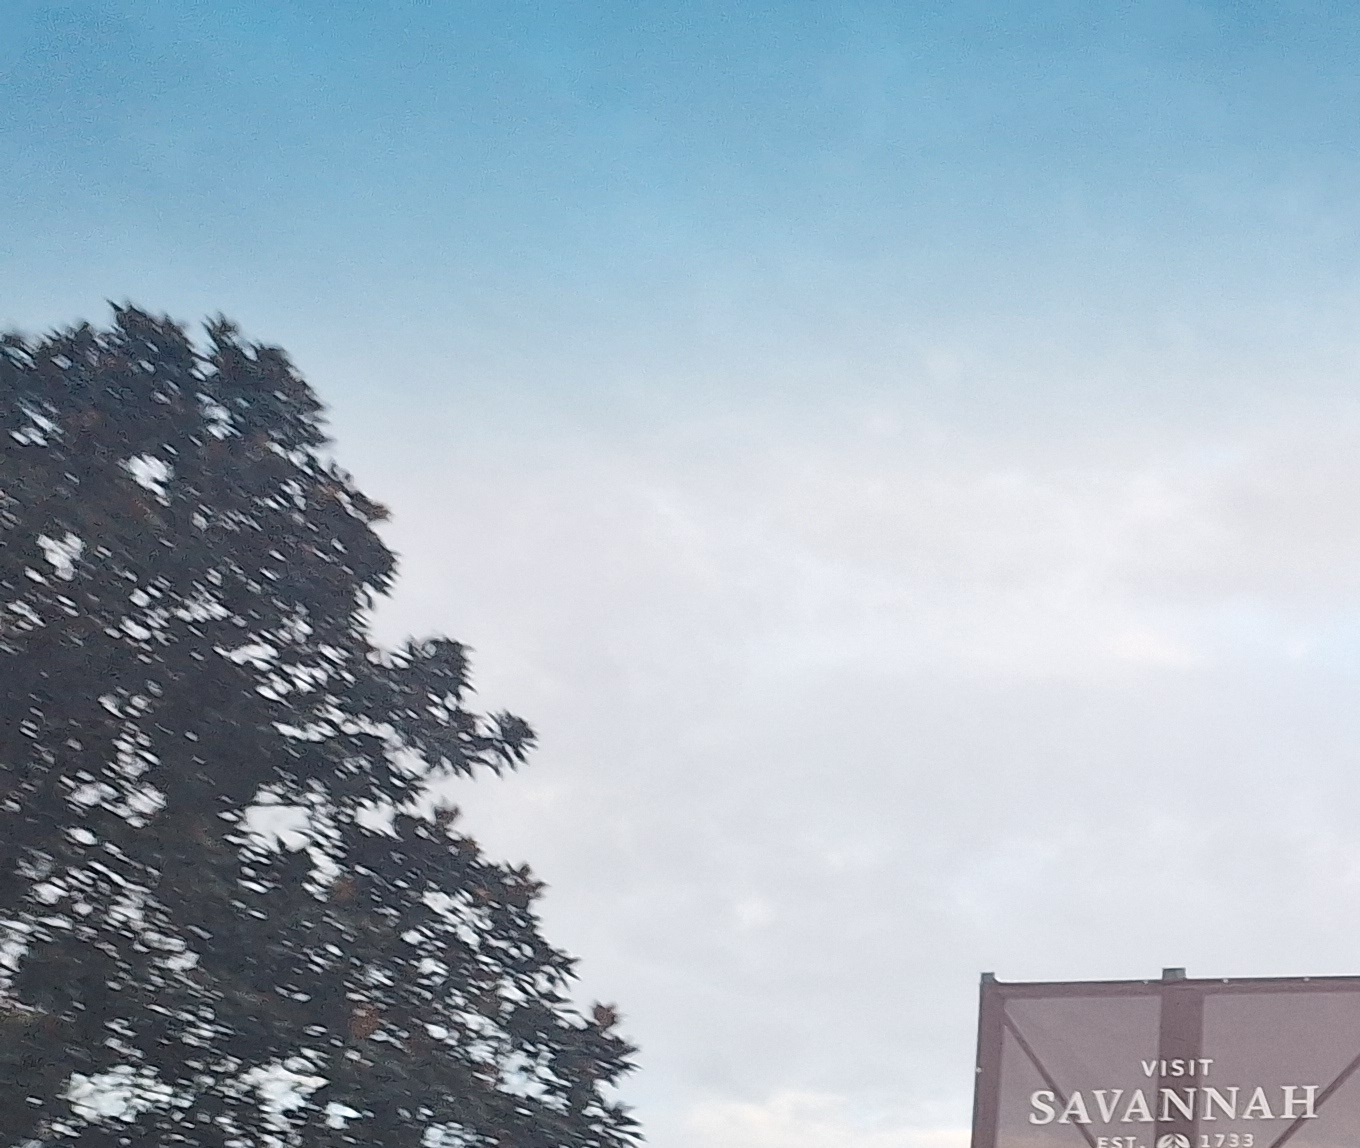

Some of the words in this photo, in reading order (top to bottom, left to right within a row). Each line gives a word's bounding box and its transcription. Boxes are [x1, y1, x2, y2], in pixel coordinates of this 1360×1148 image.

[1141, 1058, 1214, 1078] VISIT
[1028, 1084, 1320, 1125] SAVANNAH
[1200, 1133, 1255, 1148] 1733
